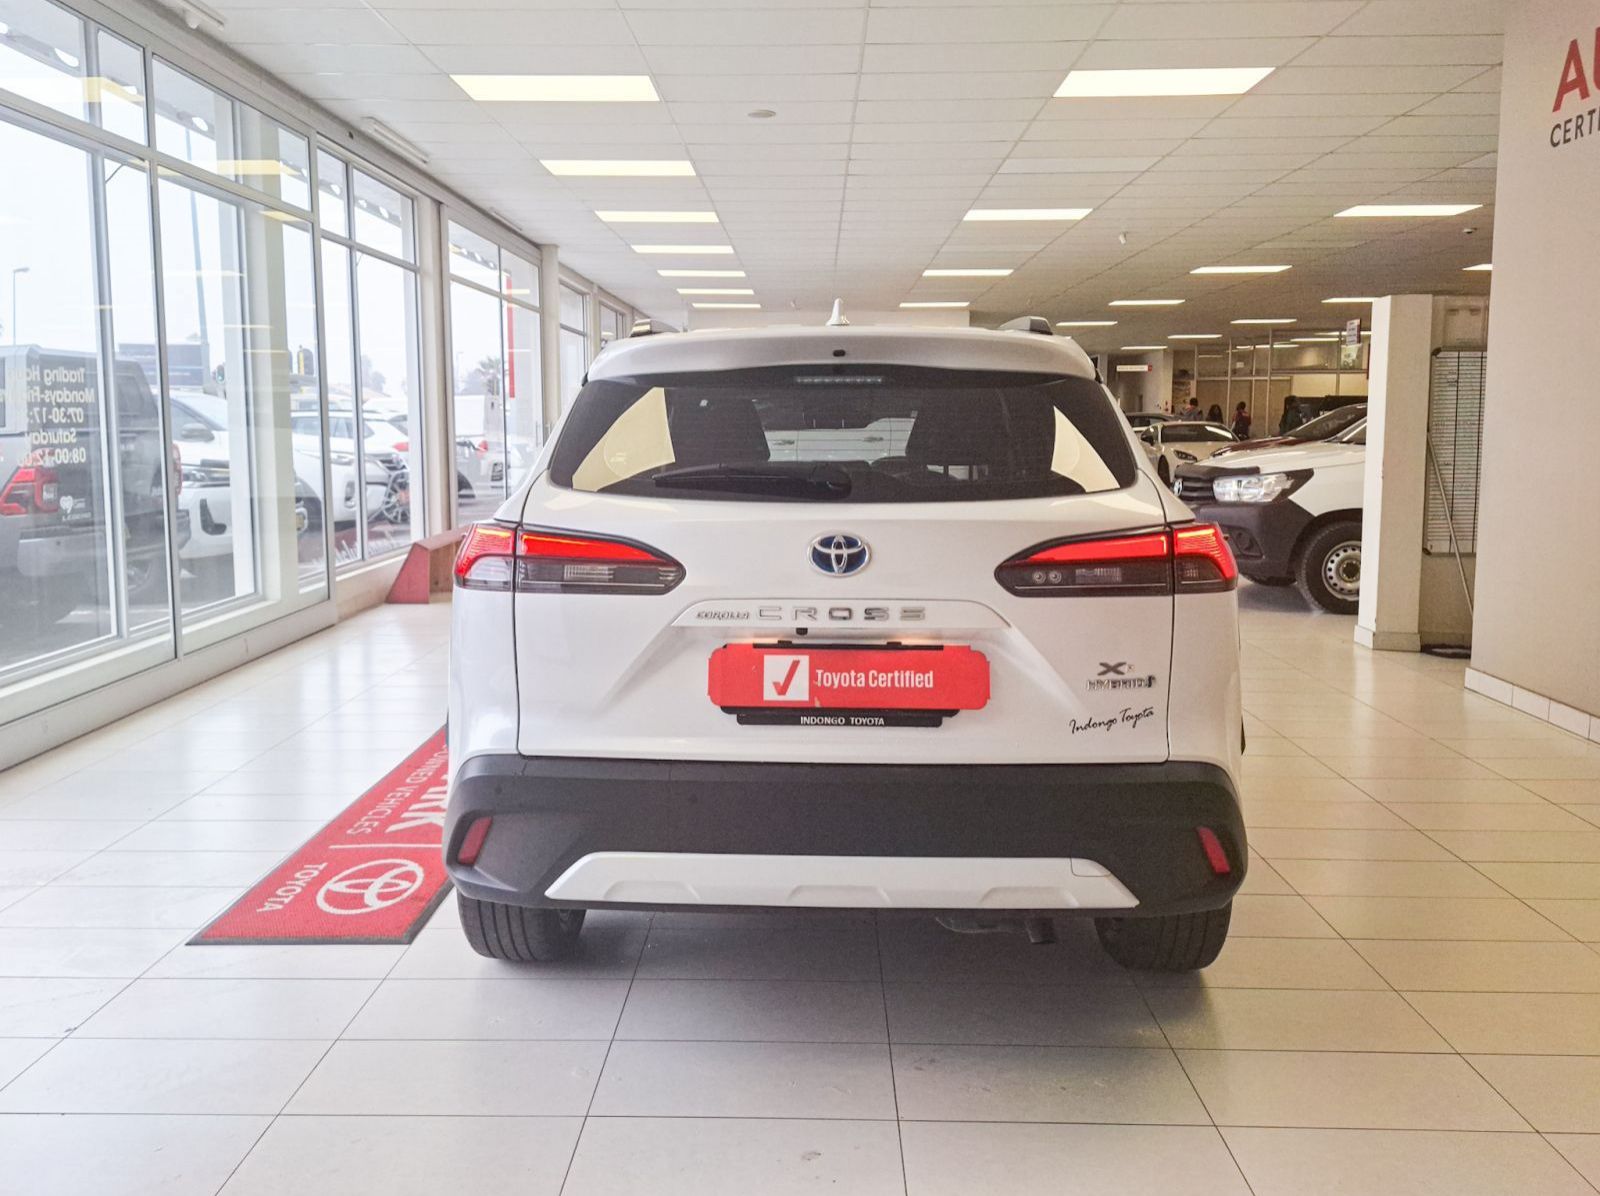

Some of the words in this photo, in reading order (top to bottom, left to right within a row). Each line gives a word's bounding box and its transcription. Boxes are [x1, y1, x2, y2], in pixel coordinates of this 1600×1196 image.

[759, 606, 926, 621] CROSS
[815, 668, 866, 689] Toyota
[868, 669, 934, 688] Certified
[800, 716, 845, 726] INDONGO
[850, 716, 885, 726] TOYOTA
[1069, 716, 1118, 735] Indongo
[1119, 705, 1154, 729] Toyota
[346, 785, 419, 834] VEHICLES
[256, 861, 328, 913] TOYOTA
